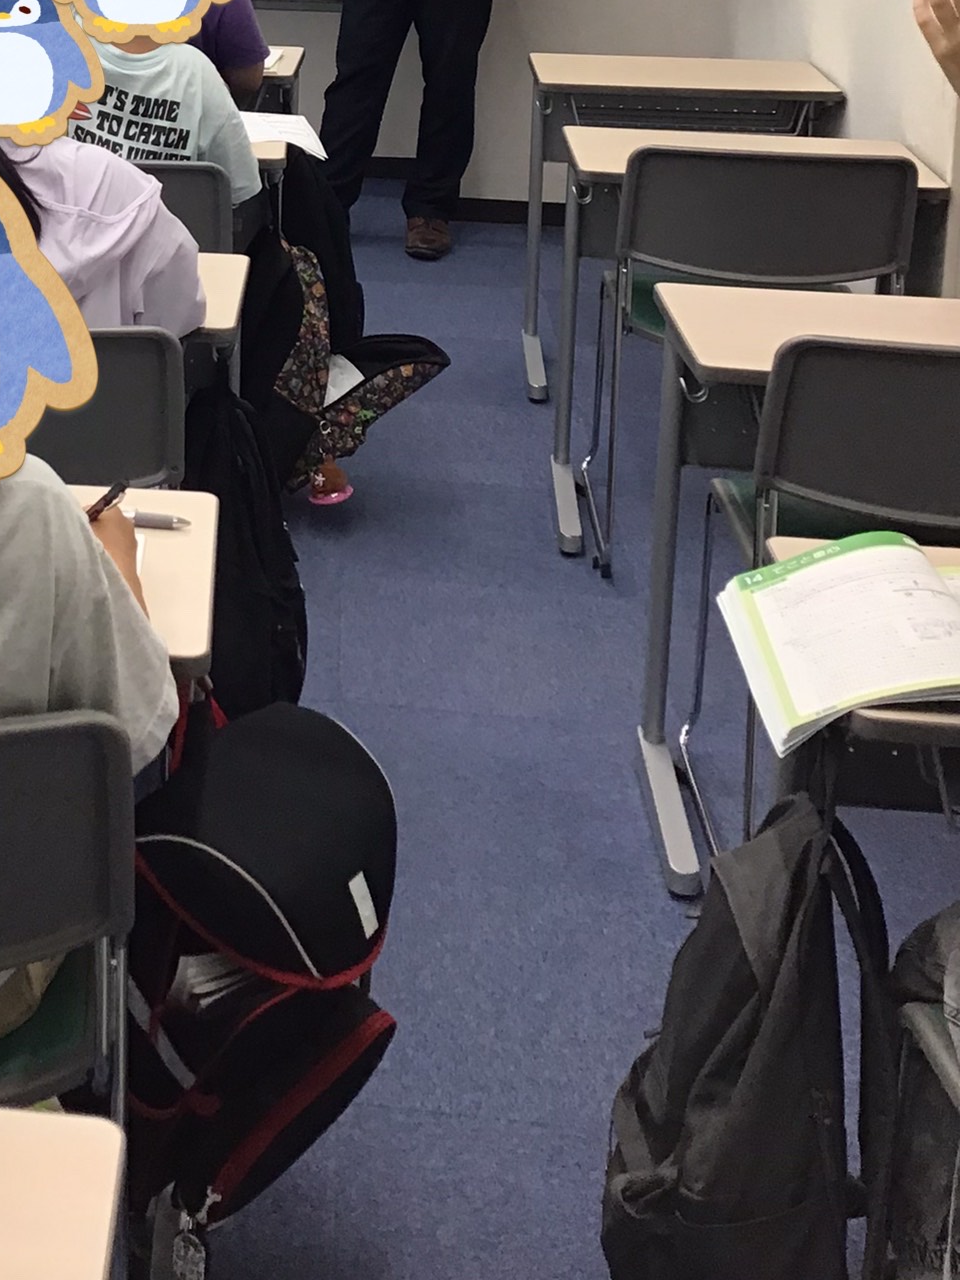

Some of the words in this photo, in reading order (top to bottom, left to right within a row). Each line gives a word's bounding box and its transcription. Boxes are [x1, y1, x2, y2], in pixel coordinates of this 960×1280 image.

[97, 85, 129, 112] T'S
[129, 94, 181, 123] TIME
[96, 110, 124, 137] TO
[123, 119, 191, 150] CATCH
[744, 573, 764, 585] 14
